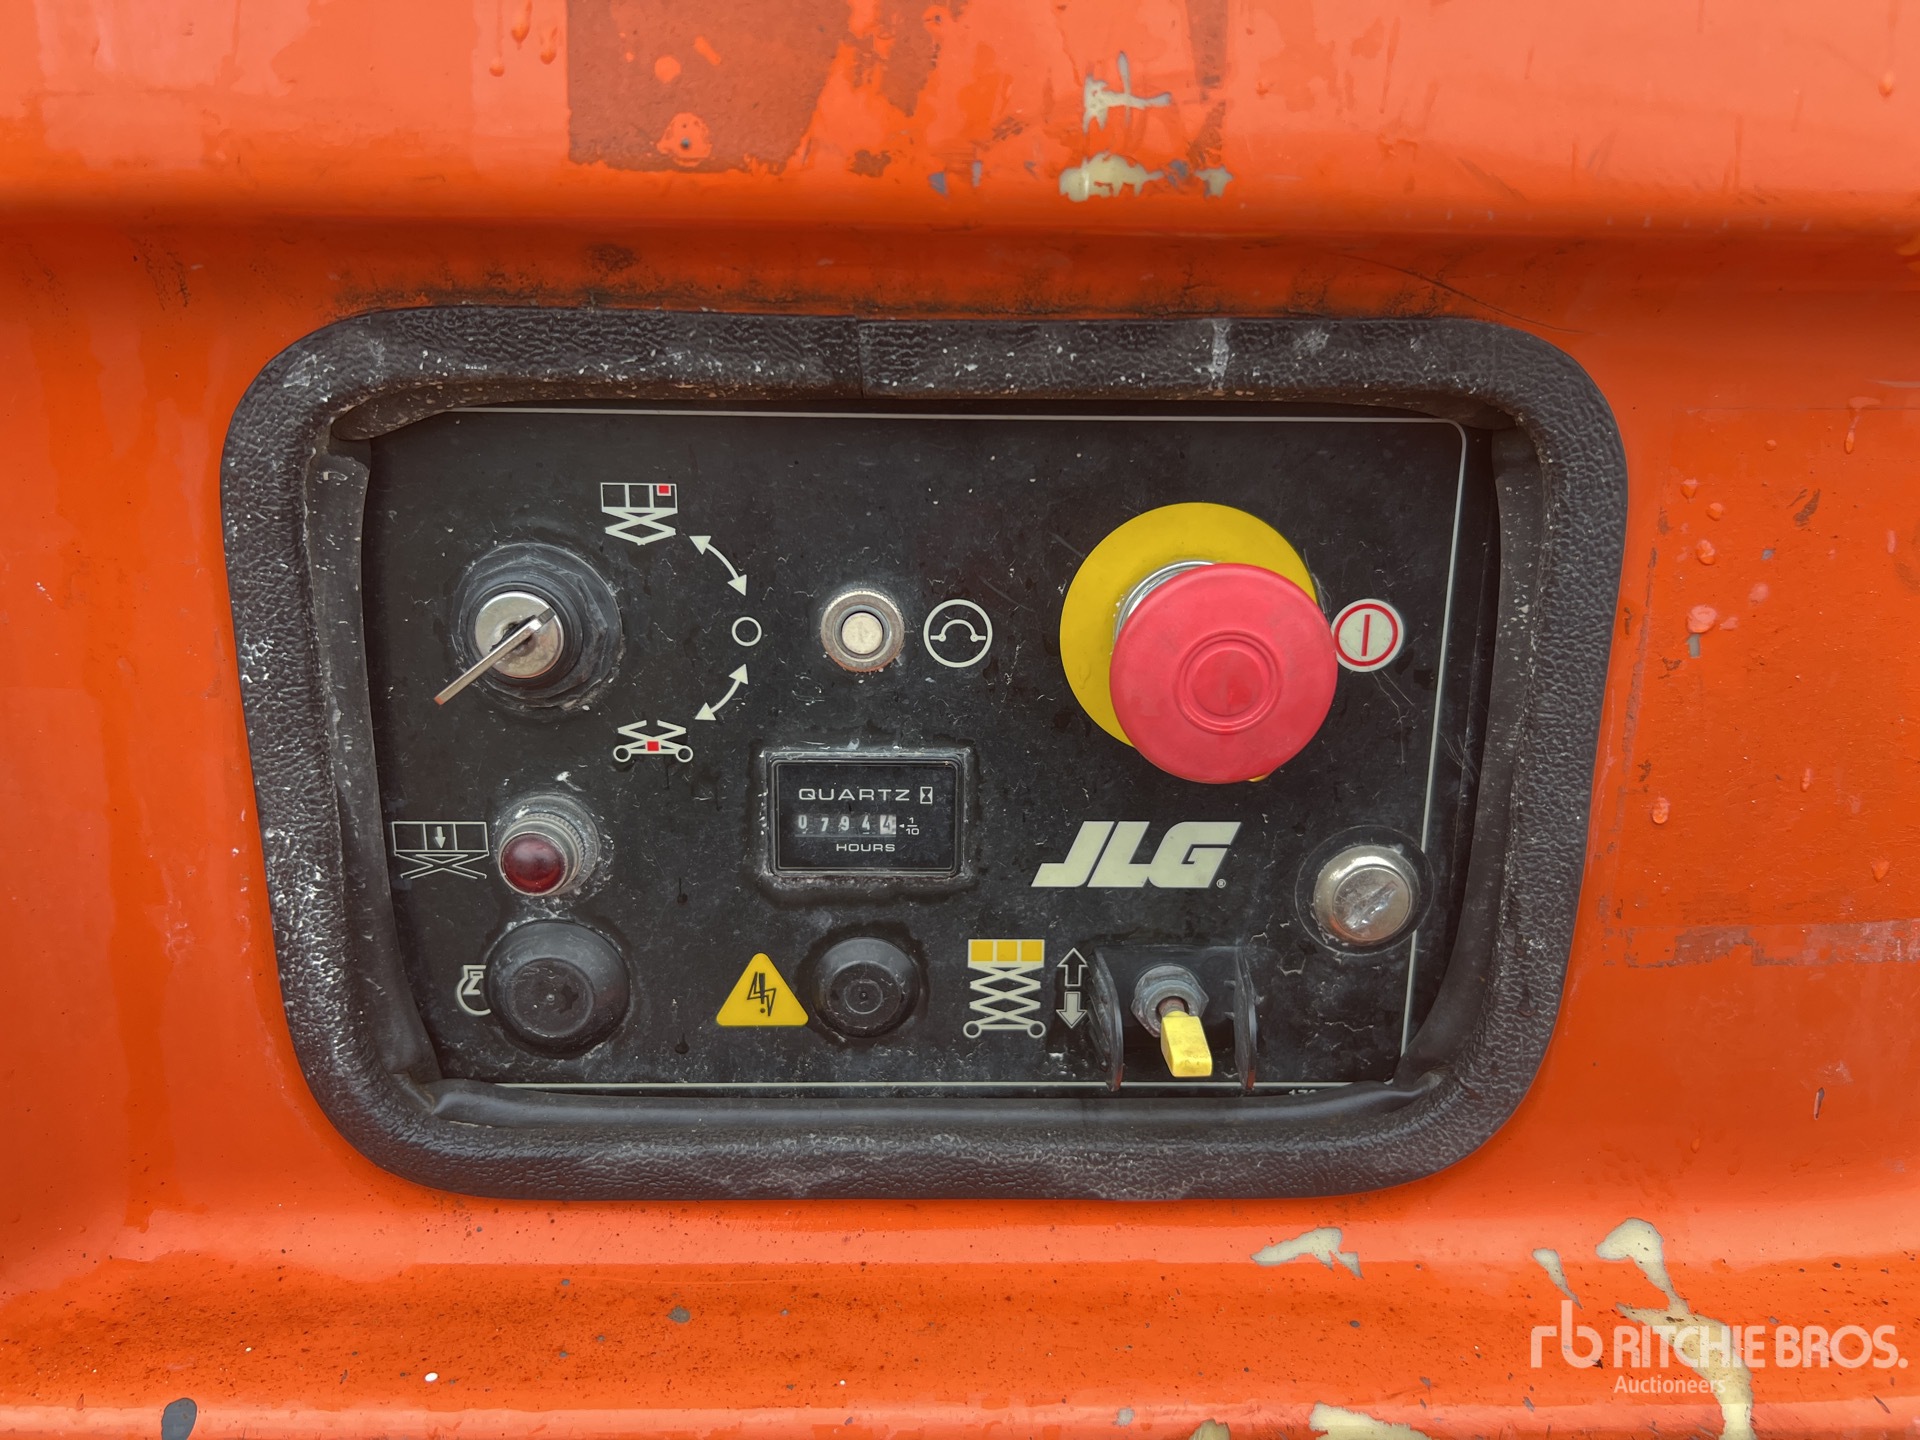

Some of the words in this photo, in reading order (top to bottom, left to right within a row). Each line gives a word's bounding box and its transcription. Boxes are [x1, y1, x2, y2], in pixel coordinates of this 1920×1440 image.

[798, 788, 910, 801] QUARTZ
[836, 843, 896, 852] HOURS
[1031, 821, 1241, 888] JLG
